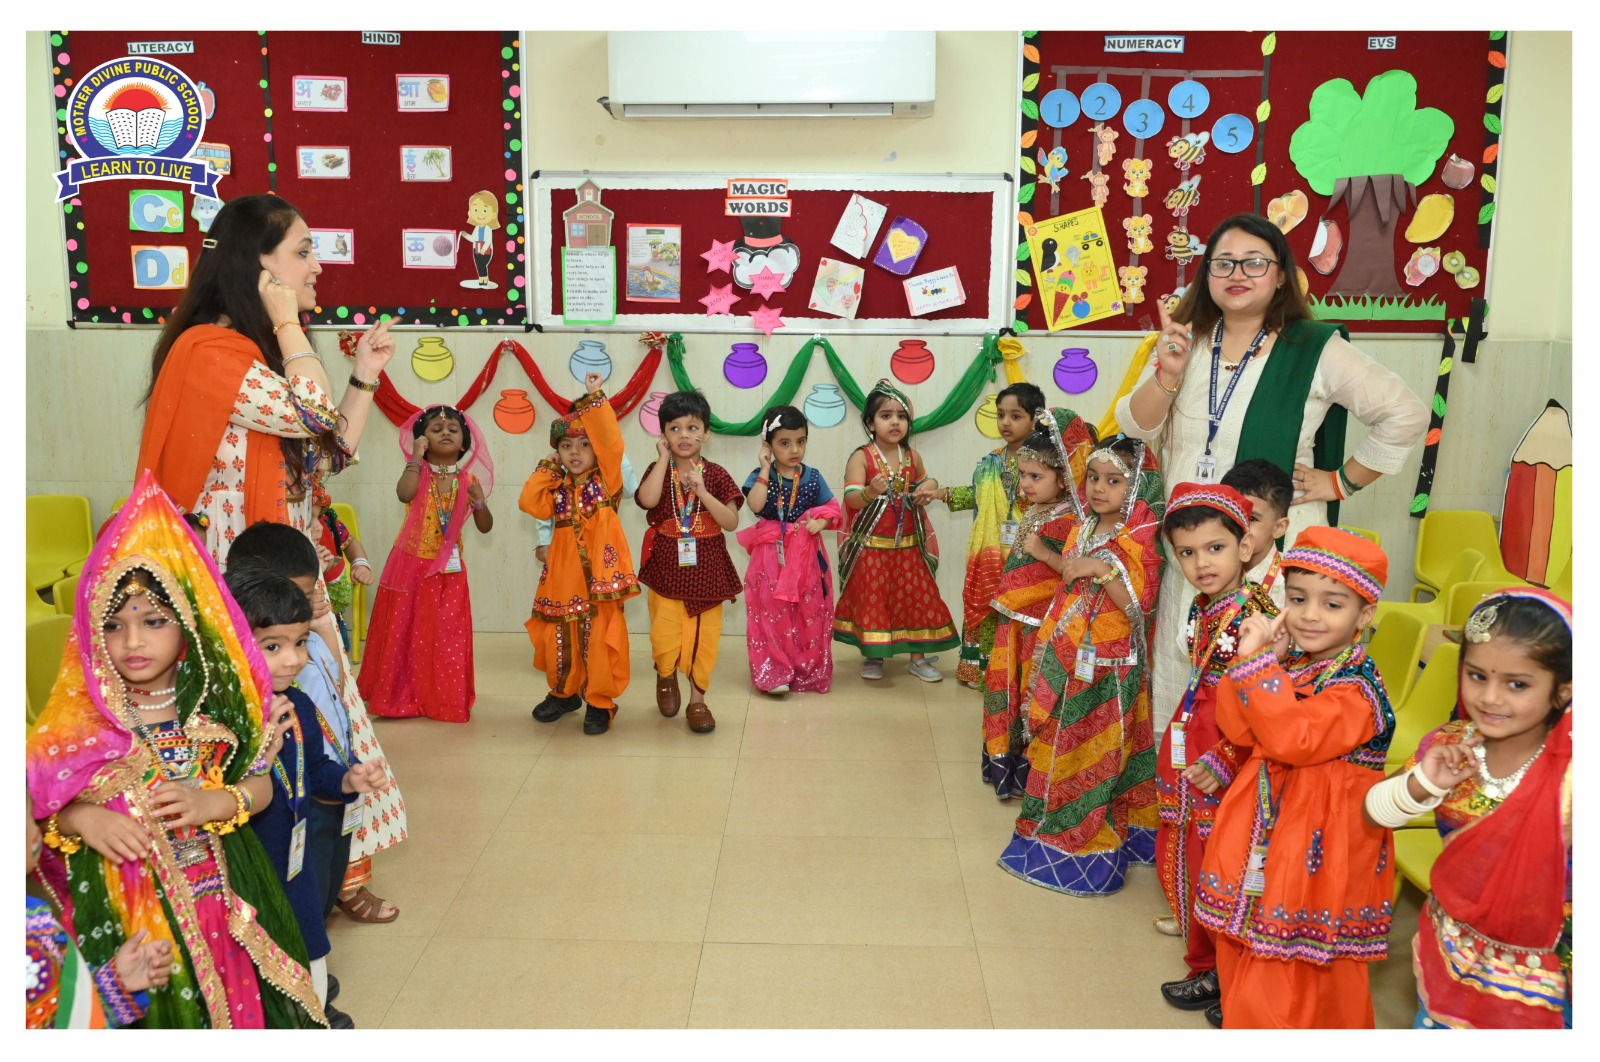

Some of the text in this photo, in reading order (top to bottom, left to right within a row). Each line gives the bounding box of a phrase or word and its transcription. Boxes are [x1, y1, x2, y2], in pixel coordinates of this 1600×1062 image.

[363, 33, 399, 43] HINDI
[1107, 39, 1181, 49] NUMERACY
[1369, 38, 1395, 48] EVS
[129, 42, 192, 53] LITERACY
[296, 80, 313, 98] अ
[399, 81, 420, 97] आ
[1094, 96, 1107, 115] 2
[1182, 94, 1195, 112] 4
[1056, 103, 1064, 122] 1
[1136, 113, 1149, 133] 3
[1227, 128, 1239, 147] 5
[301, 152, 314, 169] इ
[732, 183, 786, 195] MAGIC
[728, 202, 789, 213] WORDS
[1053, 217, 1079, 233] SHAPES
[406, 237, 425, 252] ऊ
